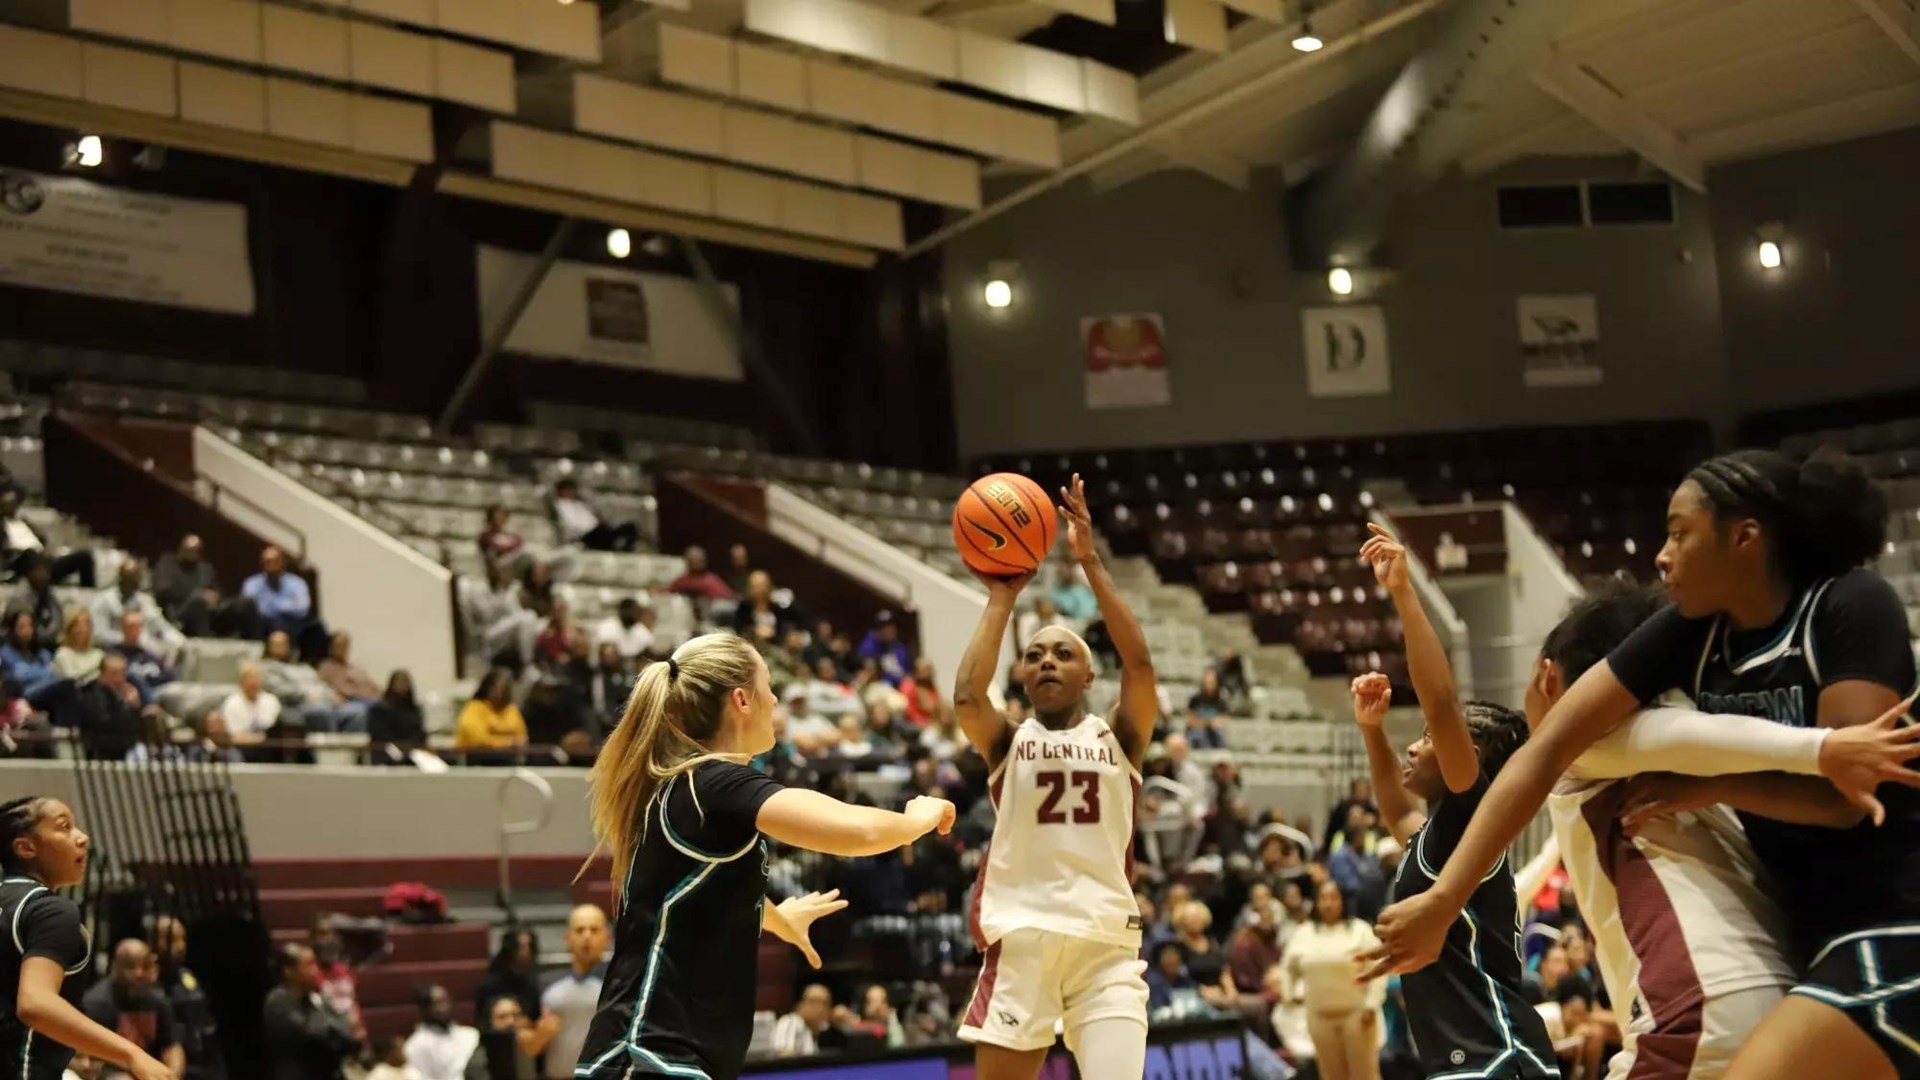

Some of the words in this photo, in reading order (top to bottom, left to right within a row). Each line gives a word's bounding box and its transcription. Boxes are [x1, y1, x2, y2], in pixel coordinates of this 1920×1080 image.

[986, 480, 1032, 529] ELITE
[1015, 740, 1036, 761] NC
[1042, 741, 1118, 766] CENTRAL
[1036, 770, 1101, 825] 23
